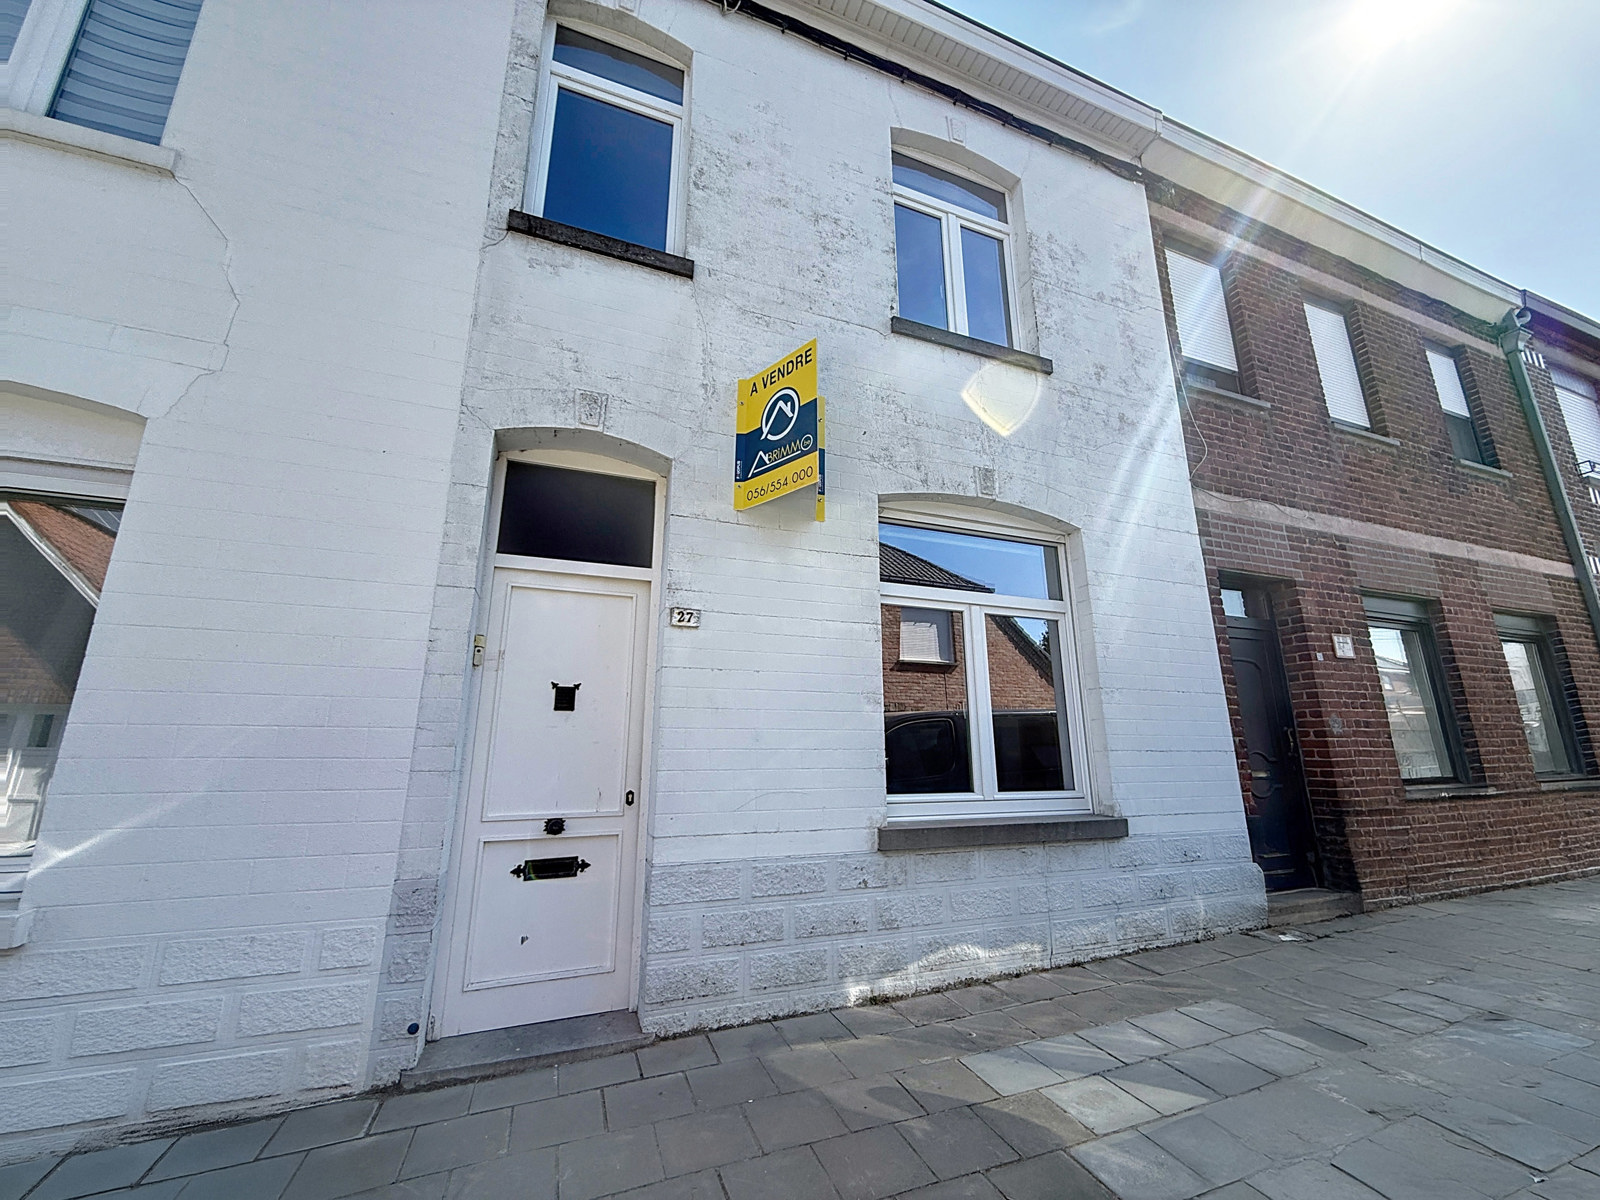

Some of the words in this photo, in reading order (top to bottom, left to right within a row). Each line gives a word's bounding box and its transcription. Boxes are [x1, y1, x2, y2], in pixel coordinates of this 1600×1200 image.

[750, 382, 758, 397] A
[762, 347, 813, 390] VENDRE
[746, 476, 789, 501] 056/554
[791, 465, 814, 484] 000
[677, 610, 694, 623] 27
